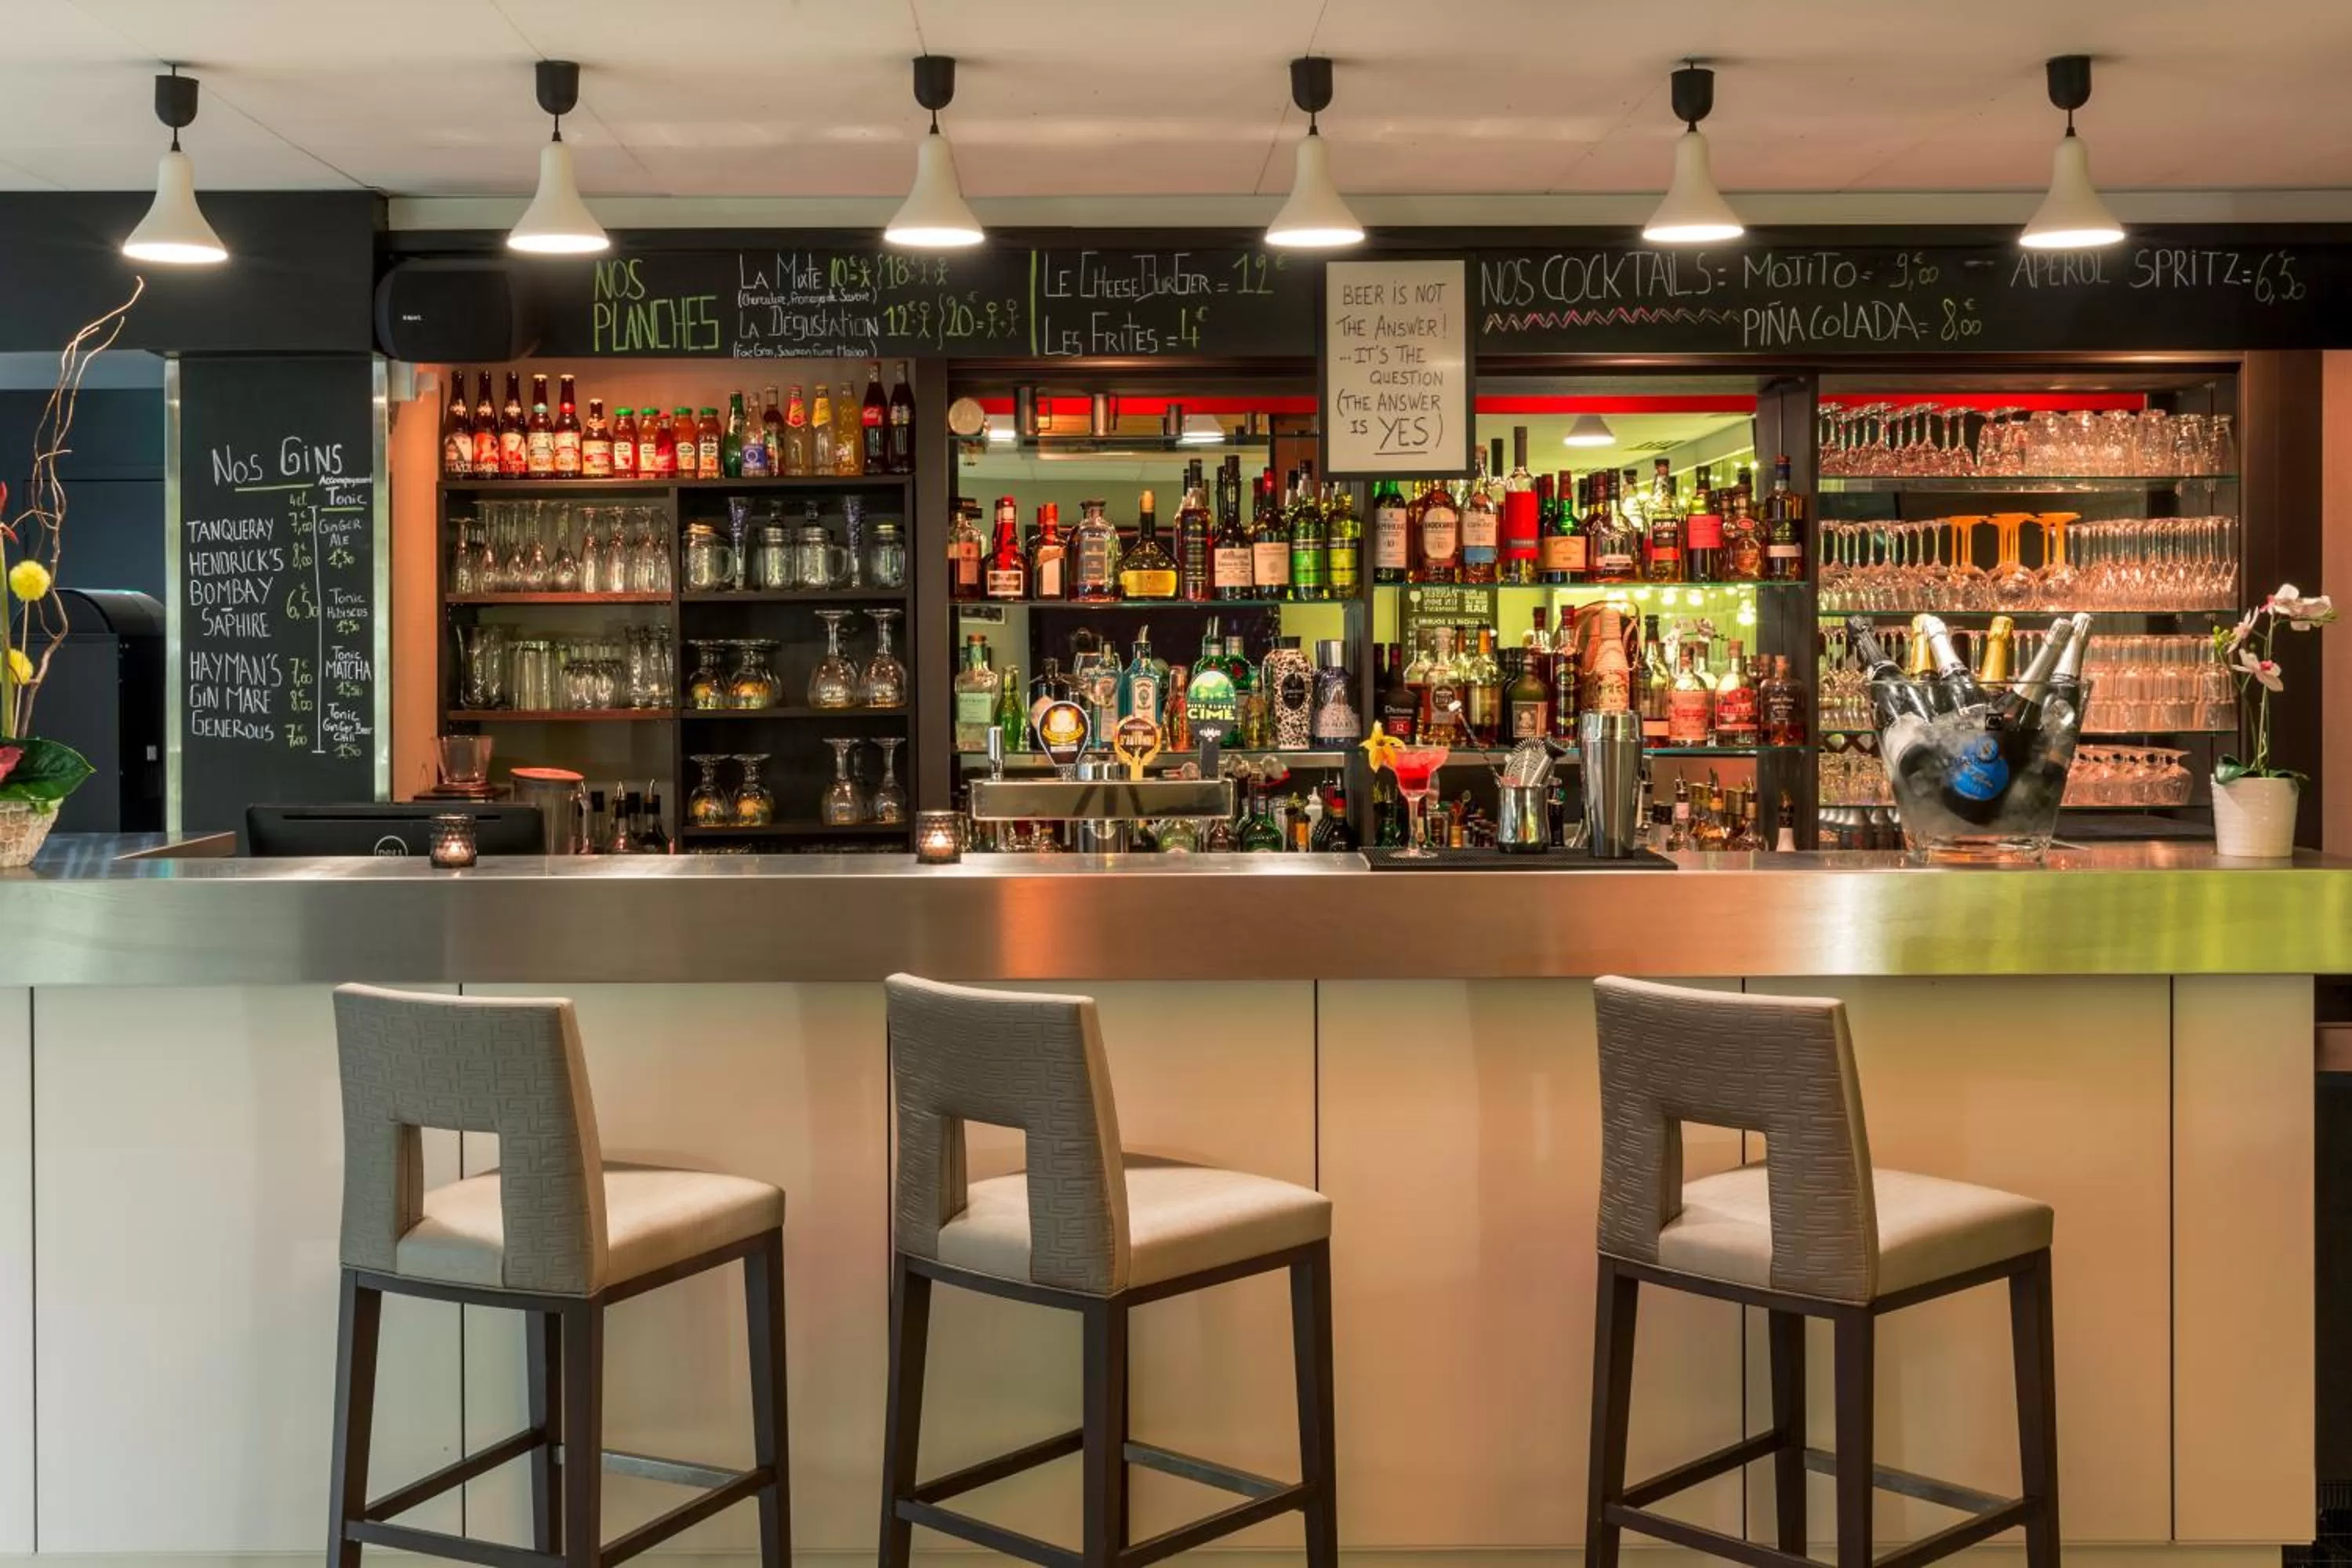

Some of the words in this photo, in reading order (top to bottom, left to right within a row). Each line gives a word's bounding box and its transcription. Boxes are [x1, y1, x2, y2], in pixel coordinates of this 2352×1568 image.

[594, 259, 645, 301] NOS
[739, 253, 769, 289] LA
[1044, 252, 1072, 297] LE
[1480, 259, 1534, 307] NOS
[2009, 250, 2111, 289] APEROL
[1342, 284, 1385, 306] BEER
[1414, 283, 1447, 304] NOT
[594, 295, 720, 353] PLANCHES
[739, 309, 760, 339] LA
[1044, 314, 1083, 358] LES
[1335, 314, 1366, 337] THE
[1744, 300, 1806, 348] PIÑA
[1395, 346, 1426, 365] THE
[1369, 370, 1443, 387] QUESTION
[1377, 392, 1441, 412] ANSWER
[1350, 419, 1369, 435] IS
[325, 486, 368, 506] Tonic
[186, 518, 274, 543] TANQUERAY
[189, 547, 285, 576] HENDRICK'S
[190, 577, 274, 606] BOMBAY
[328, 586, 365, 604] Tonic
[331, 645, 362, 661] Tonic
[190, 652, 282, 688] HAYMAN'S
[325, 659, 372, 681] MATCHA
[189, 684, 220, 710] GIN
[226, 686, 273, 714] MARE
[327, 702, 360, 721] Tonic
[191, 710, 274, 742] GENEROUS
[1187, 708, 1235, 720] CIME
